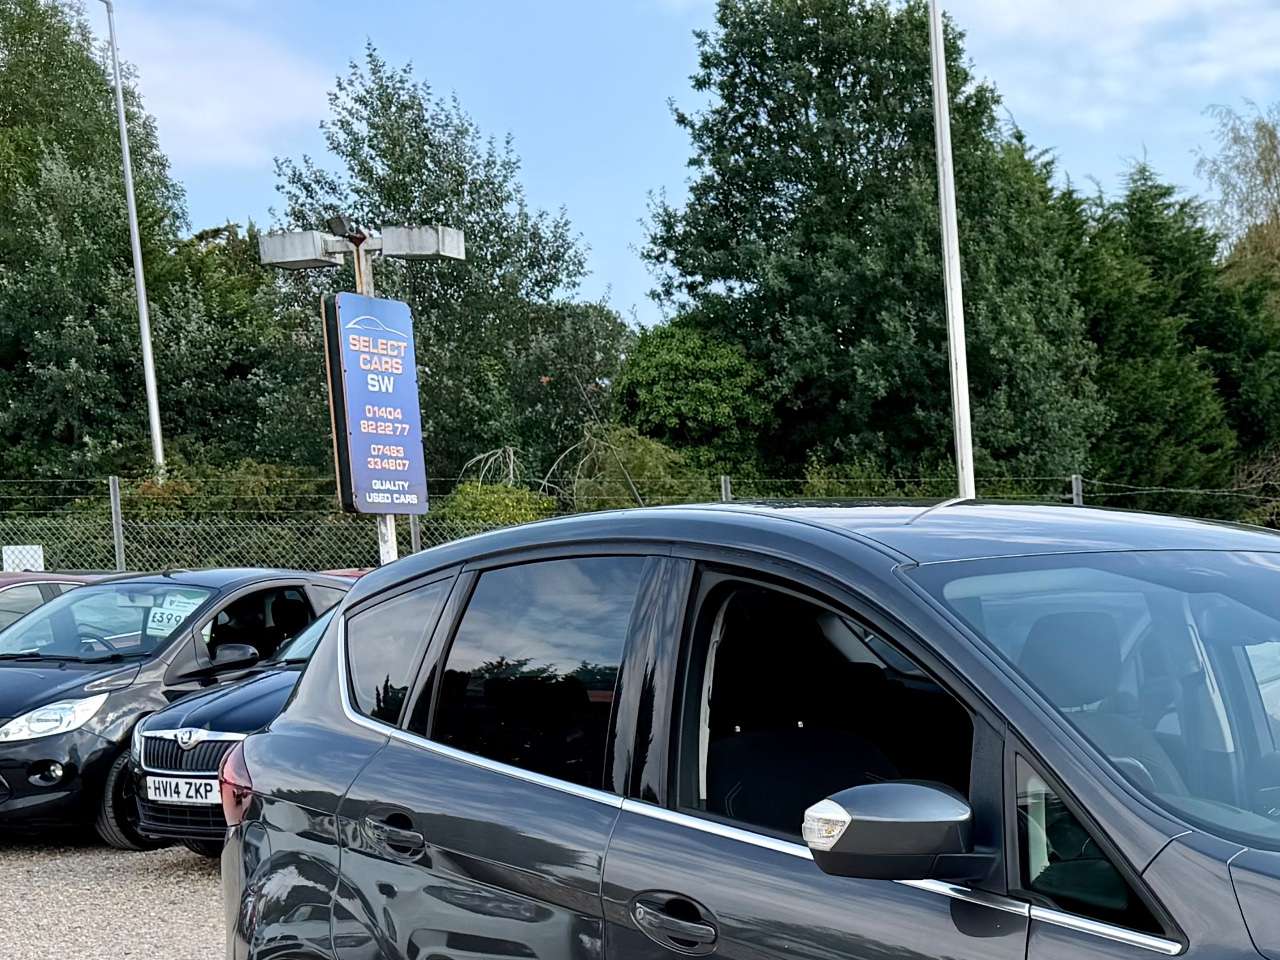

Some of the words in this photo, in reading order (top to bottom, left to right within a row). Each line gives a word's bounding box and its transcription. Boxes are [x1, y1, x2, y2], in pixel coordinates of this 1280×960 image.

[349, 334, 408, 357] SELECT
[359, 353, 403, 375] CARS
[367, 373, 394, 393] SW
[365, 404, 402, 420] 01404
[360, 420, 410, 436] 822277
[371, 479, 409, 491] QUALITY
[365, 492, 391, 504] USED
[393, 493, 418, 505] CARS
[151, 611, 182, 626] £399
[152, 779, 181, 799] HV14
[184, 780, 214, 800] ZKP
